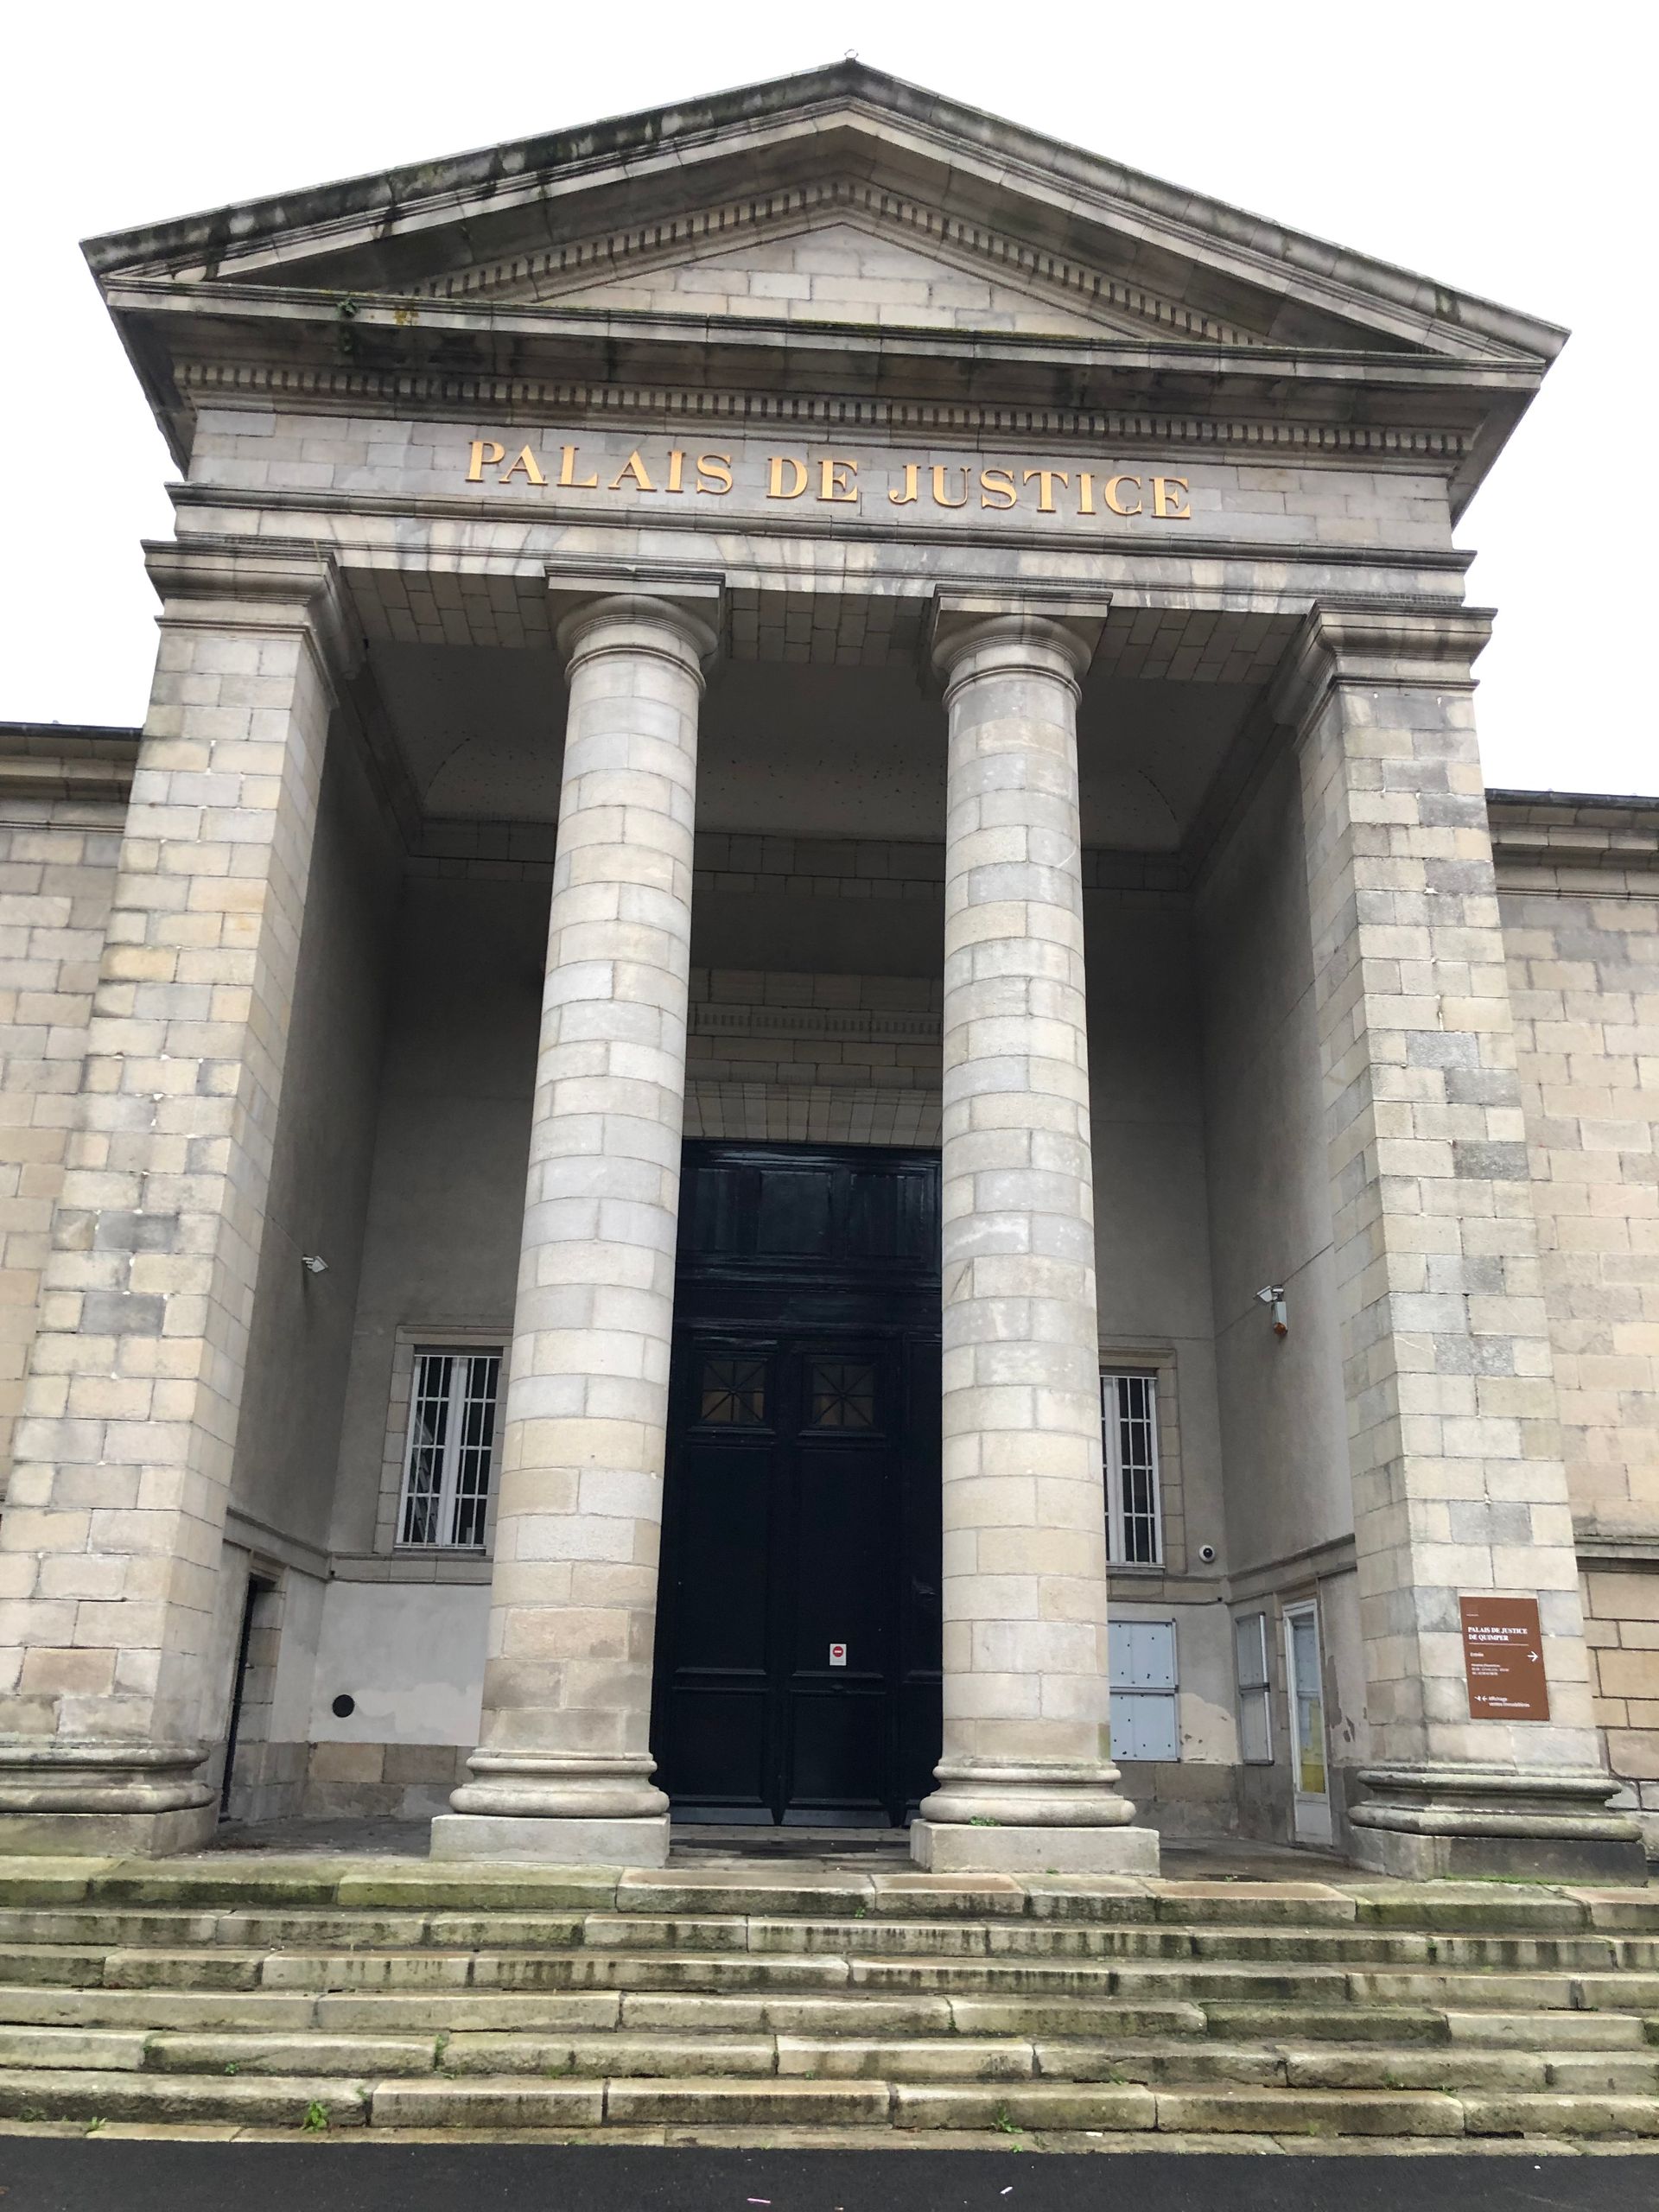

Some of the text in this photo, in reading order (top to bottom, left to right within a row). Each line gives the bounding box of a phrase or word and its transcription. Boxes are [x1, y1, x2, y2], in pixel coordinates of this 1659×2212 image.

[465, 441, 1191, 519] PALAIS DE JUSTICE
